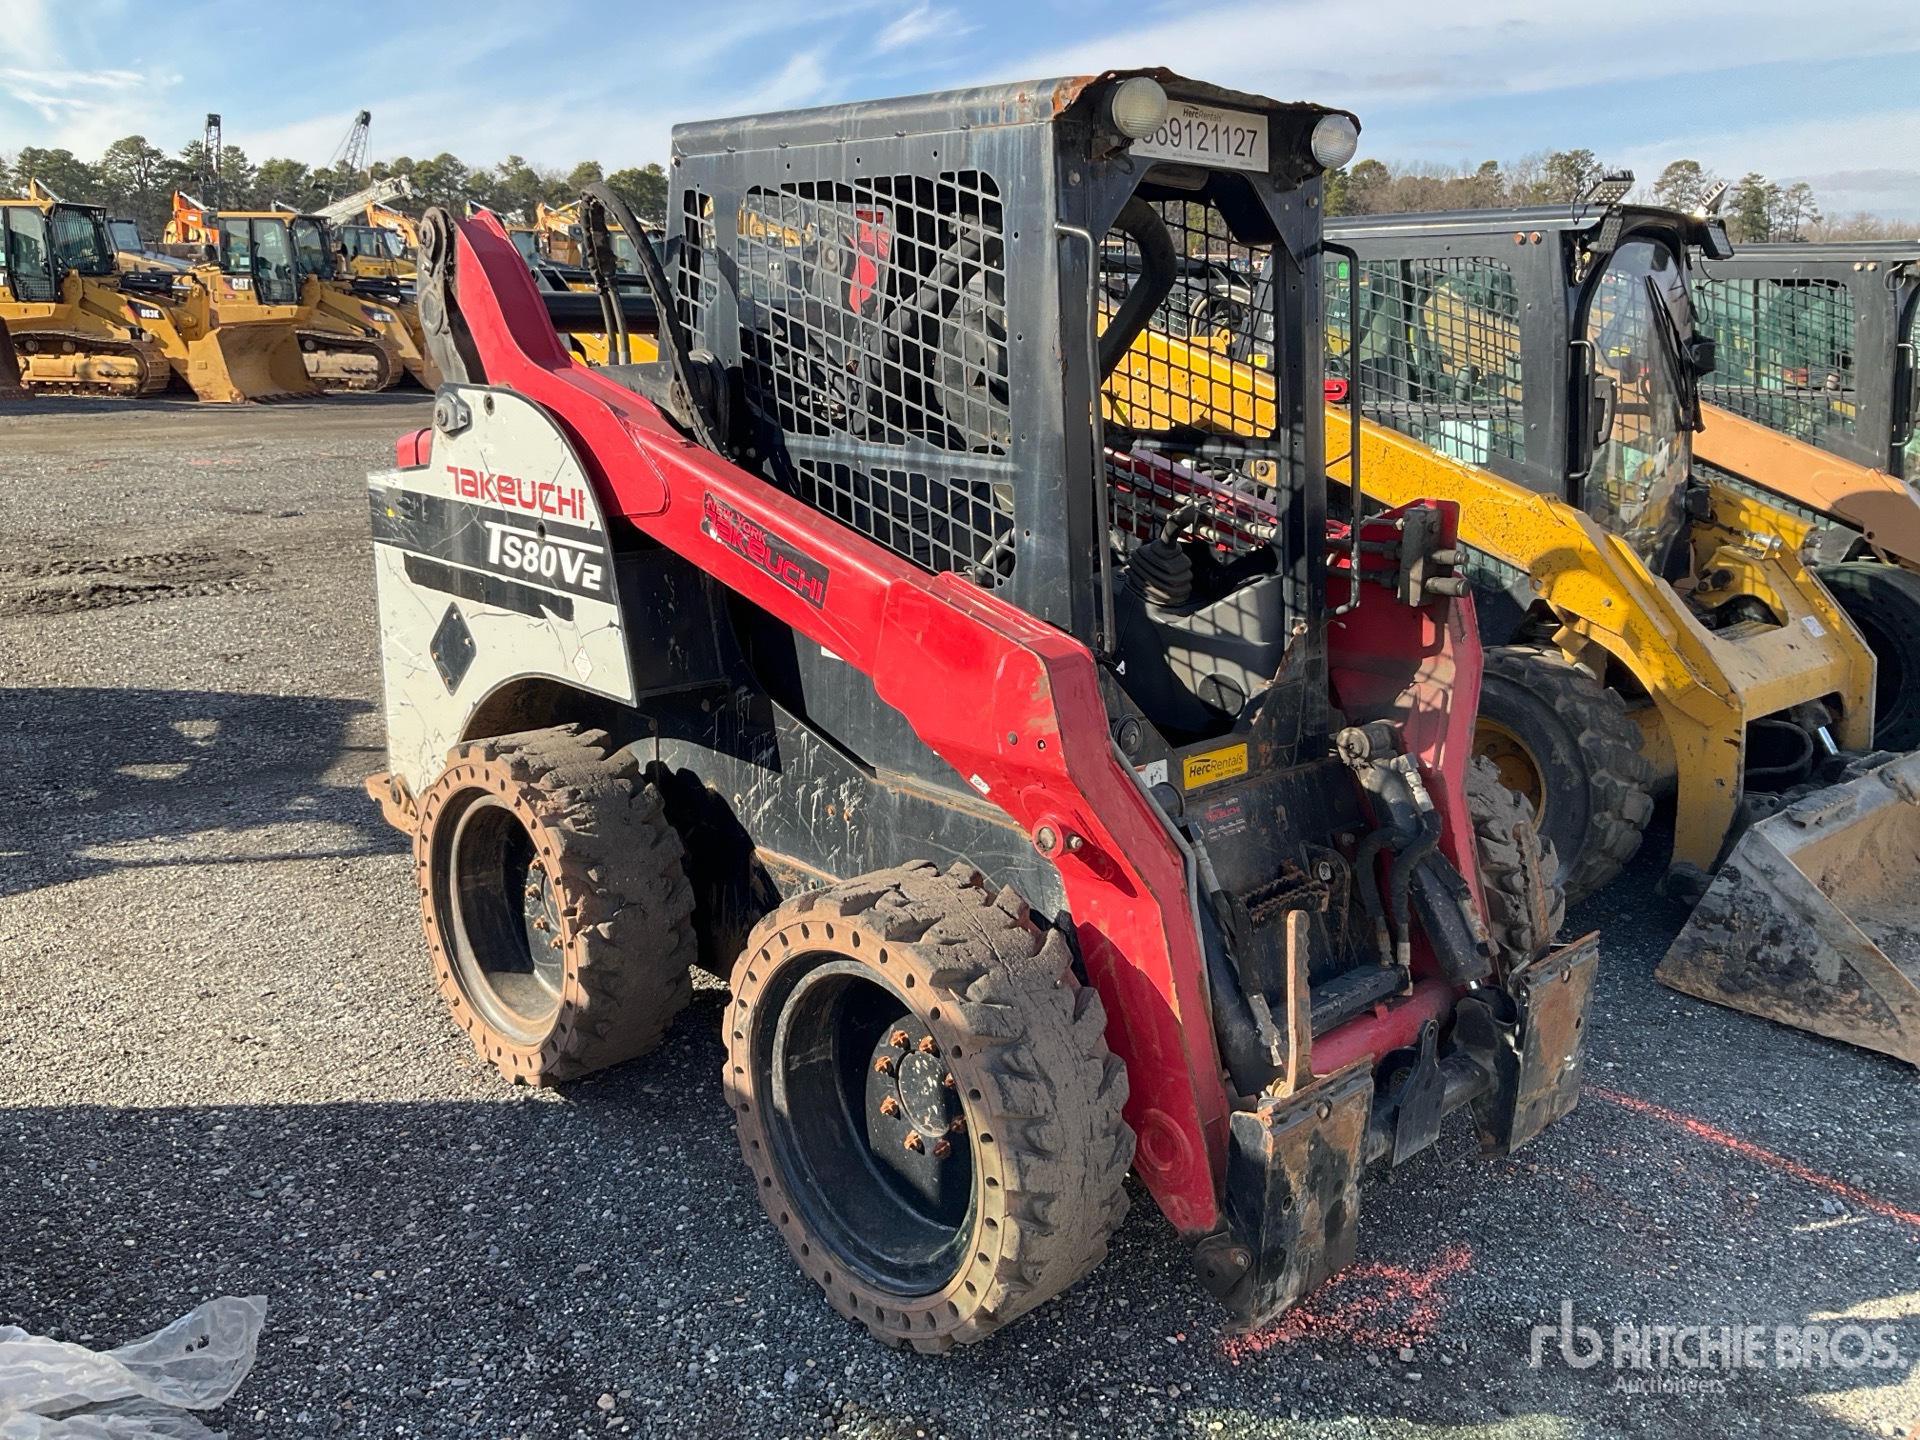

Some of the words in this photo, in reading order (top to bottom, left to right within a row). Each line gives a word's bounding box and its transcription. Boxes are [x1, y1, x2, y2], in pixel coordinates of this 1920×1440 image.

[231, 278, 249, 291] CAT
[735, 512, 769, 545] YORK
[1189, 752, 1243, 778] HercRentals
